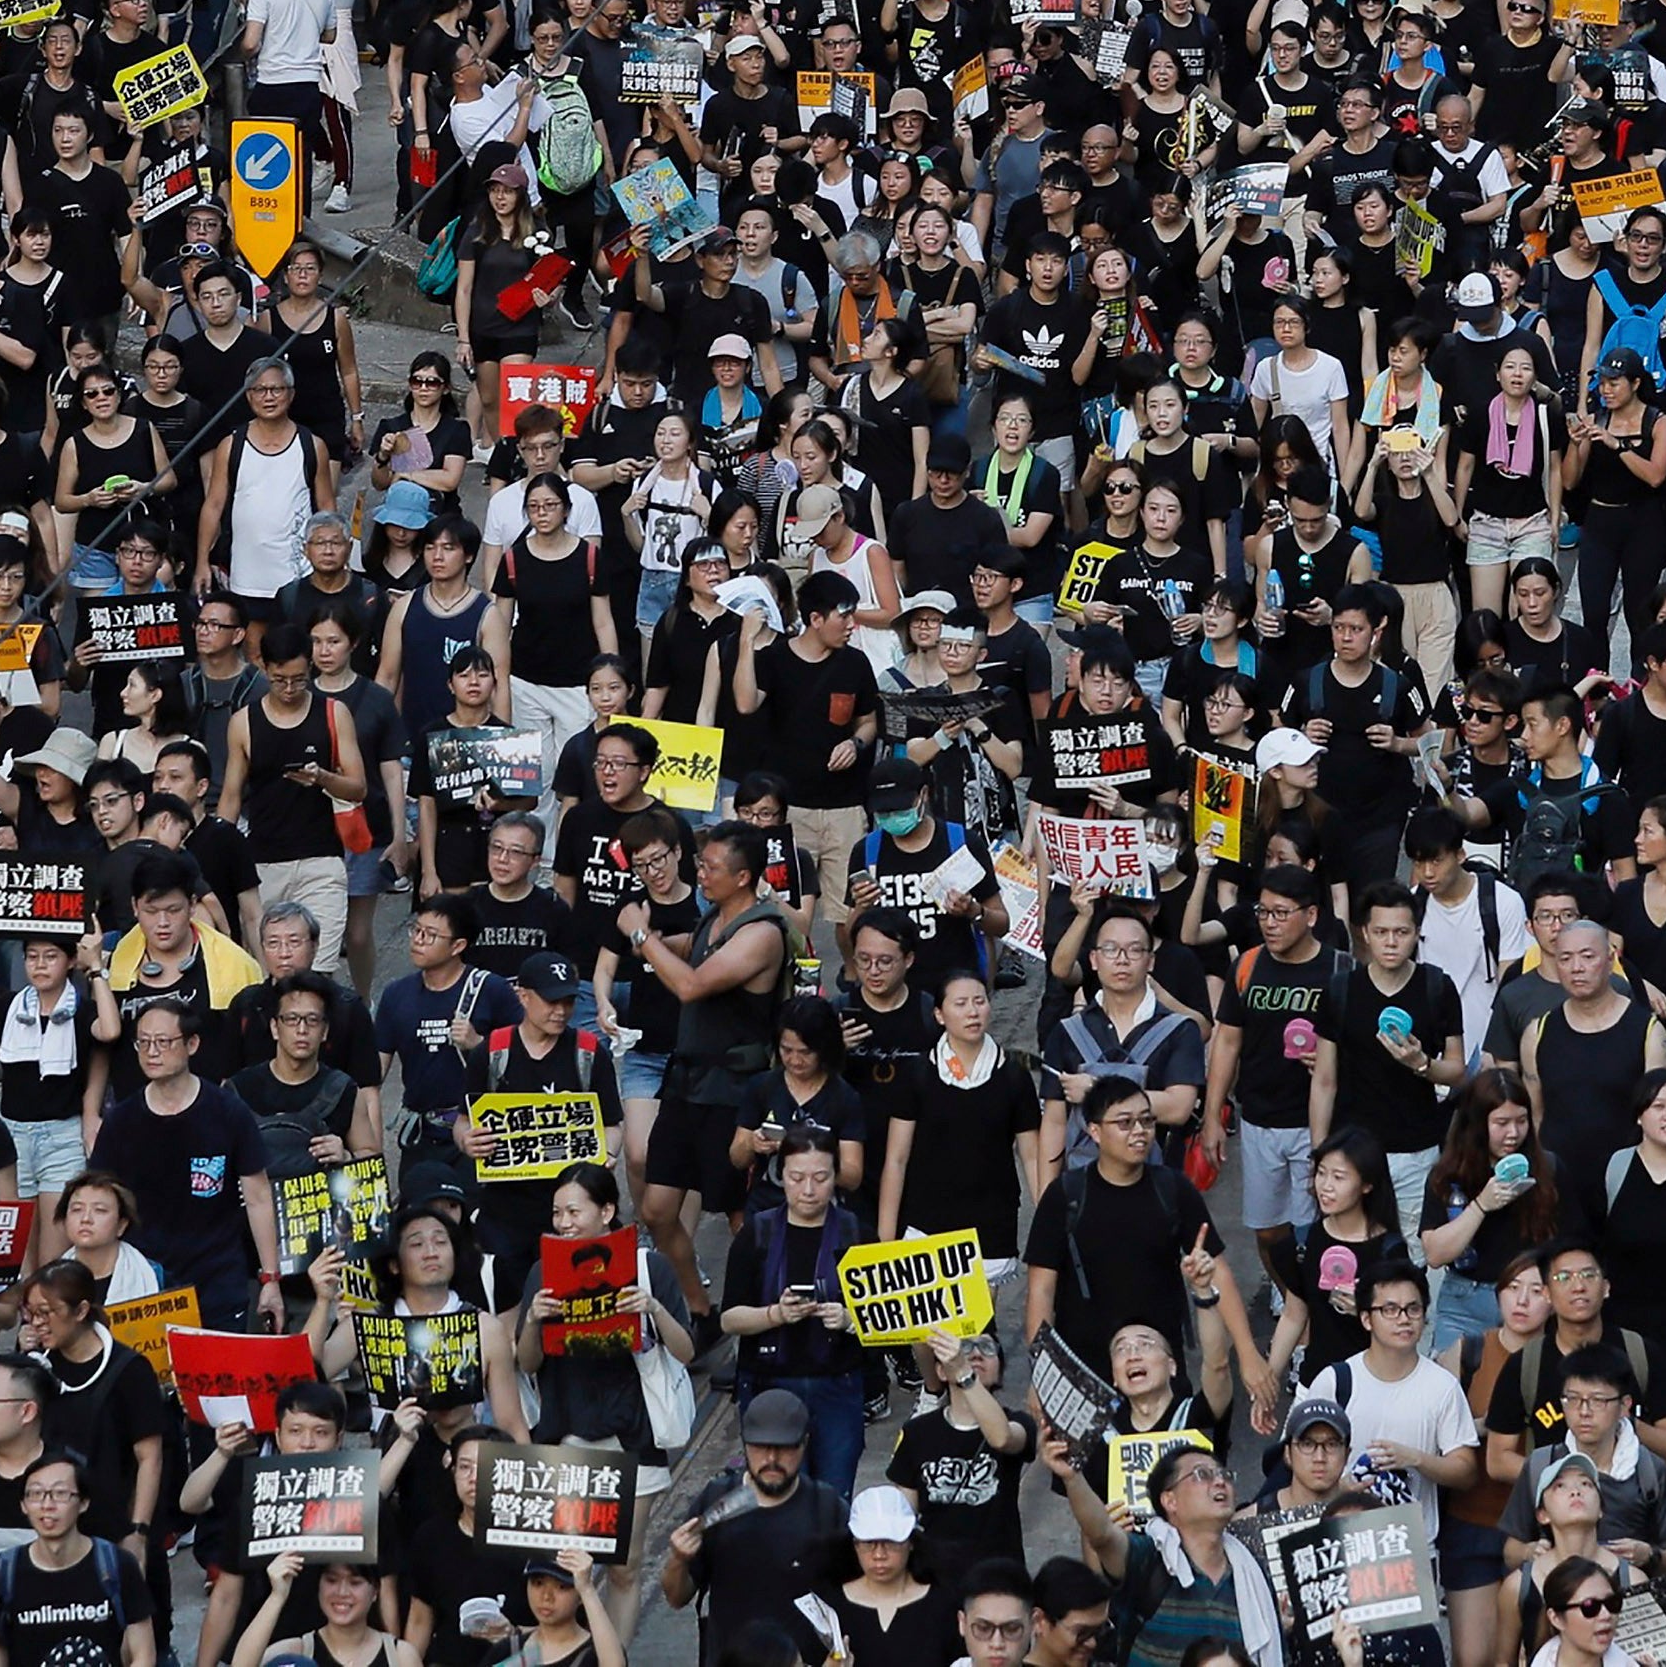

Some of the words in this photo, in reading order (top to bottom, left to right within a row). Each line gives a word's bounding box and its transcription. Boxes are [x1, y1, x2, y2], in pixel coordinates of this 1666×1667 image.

[121, 56, 192, 96] 企硬立場
[1332, 174, 1357, 183] CHAOS
[1359, 170, 1388, 181] THEORY
[250, 197, 277, 208] B893
[1020, 355, 1060, 368] adidas
[508, 377, 586, 404] 賣港賊
[90, 603, 176, 627] 獨立調查
[1052, 722, 1143, 749] 獨立調查
[1041, 821, 1137, 848] 相信青年
[588, 837, 609, 864] I
[1047, 847, 1142, 879] 相信人民
[583, 868, 643, 891] ARTS
[479, 1102, 595, 1132] 企硬立場
[846, 1253, 934, 1297] STAND
[939, 1246, 976, 1277] UP
[855, 1299, 905, 1334] FOR
[254, 1466, 365, 1501] 獨立調查
[493, 1457, 619, 1500] 獨立調查
[1294, 1523, 1411, 1583] 獨立調查
